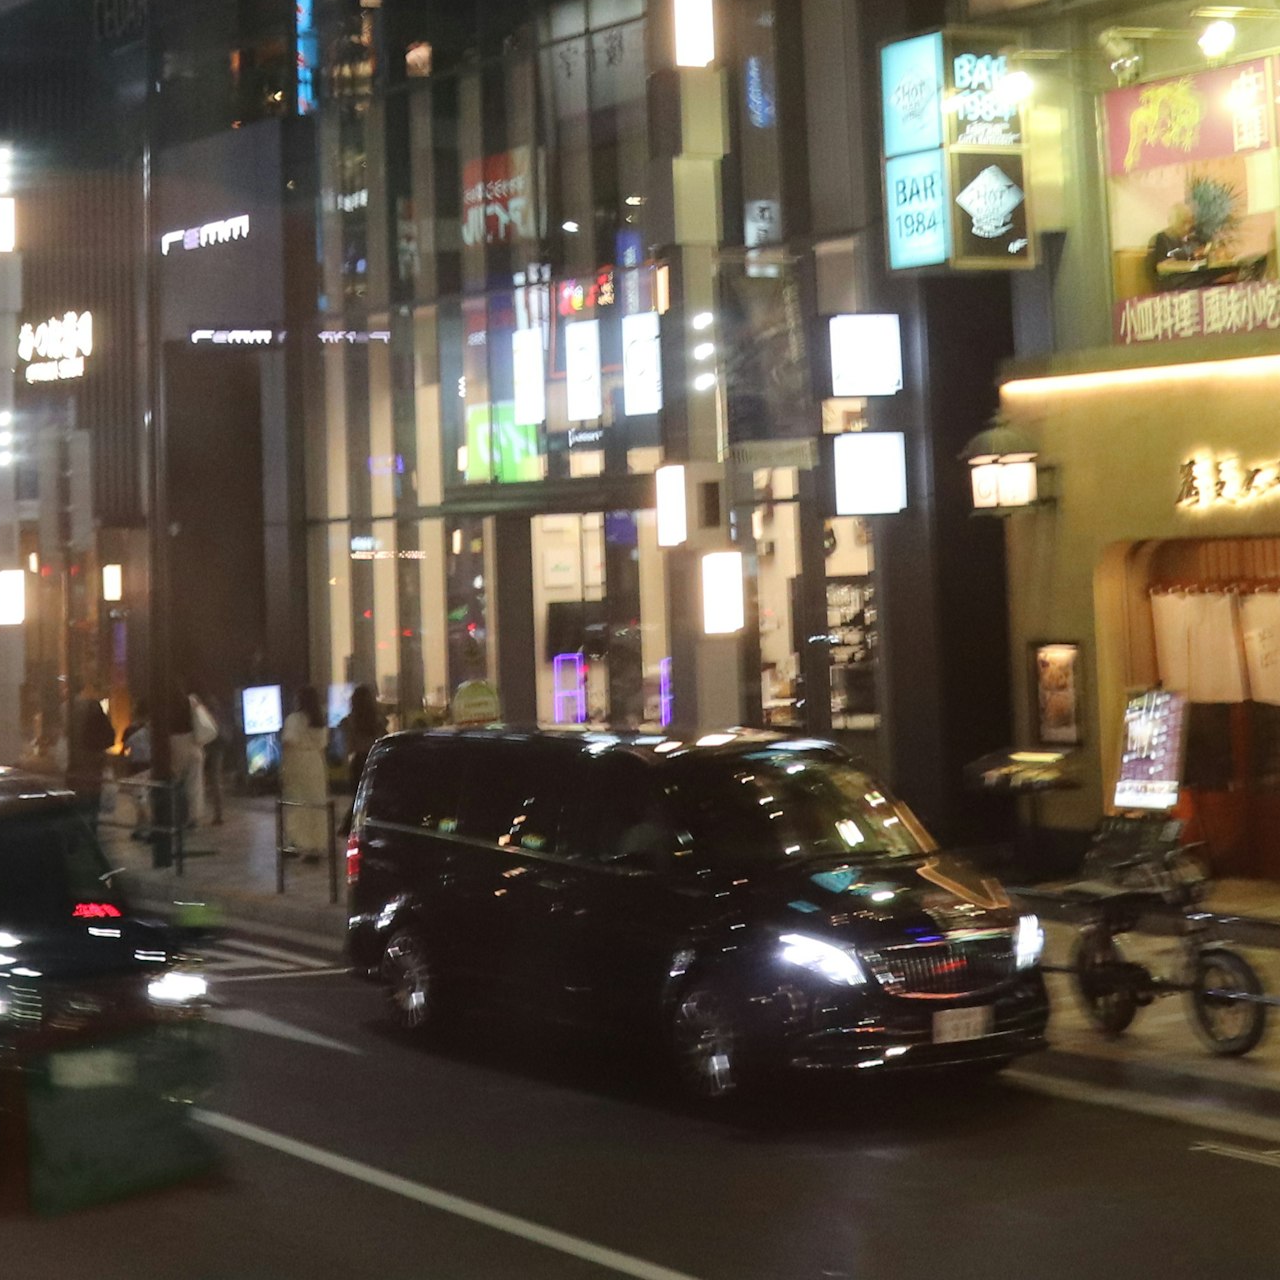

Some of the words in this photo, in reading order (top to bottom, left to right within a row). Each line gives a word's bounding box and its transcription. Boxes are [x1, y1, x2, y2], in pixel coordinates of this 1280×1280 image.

[895, 173, 936, 208] BAR
[896, 210, 938, 239] 1984
[1121, 289, 1201, 344] 小皿料理
